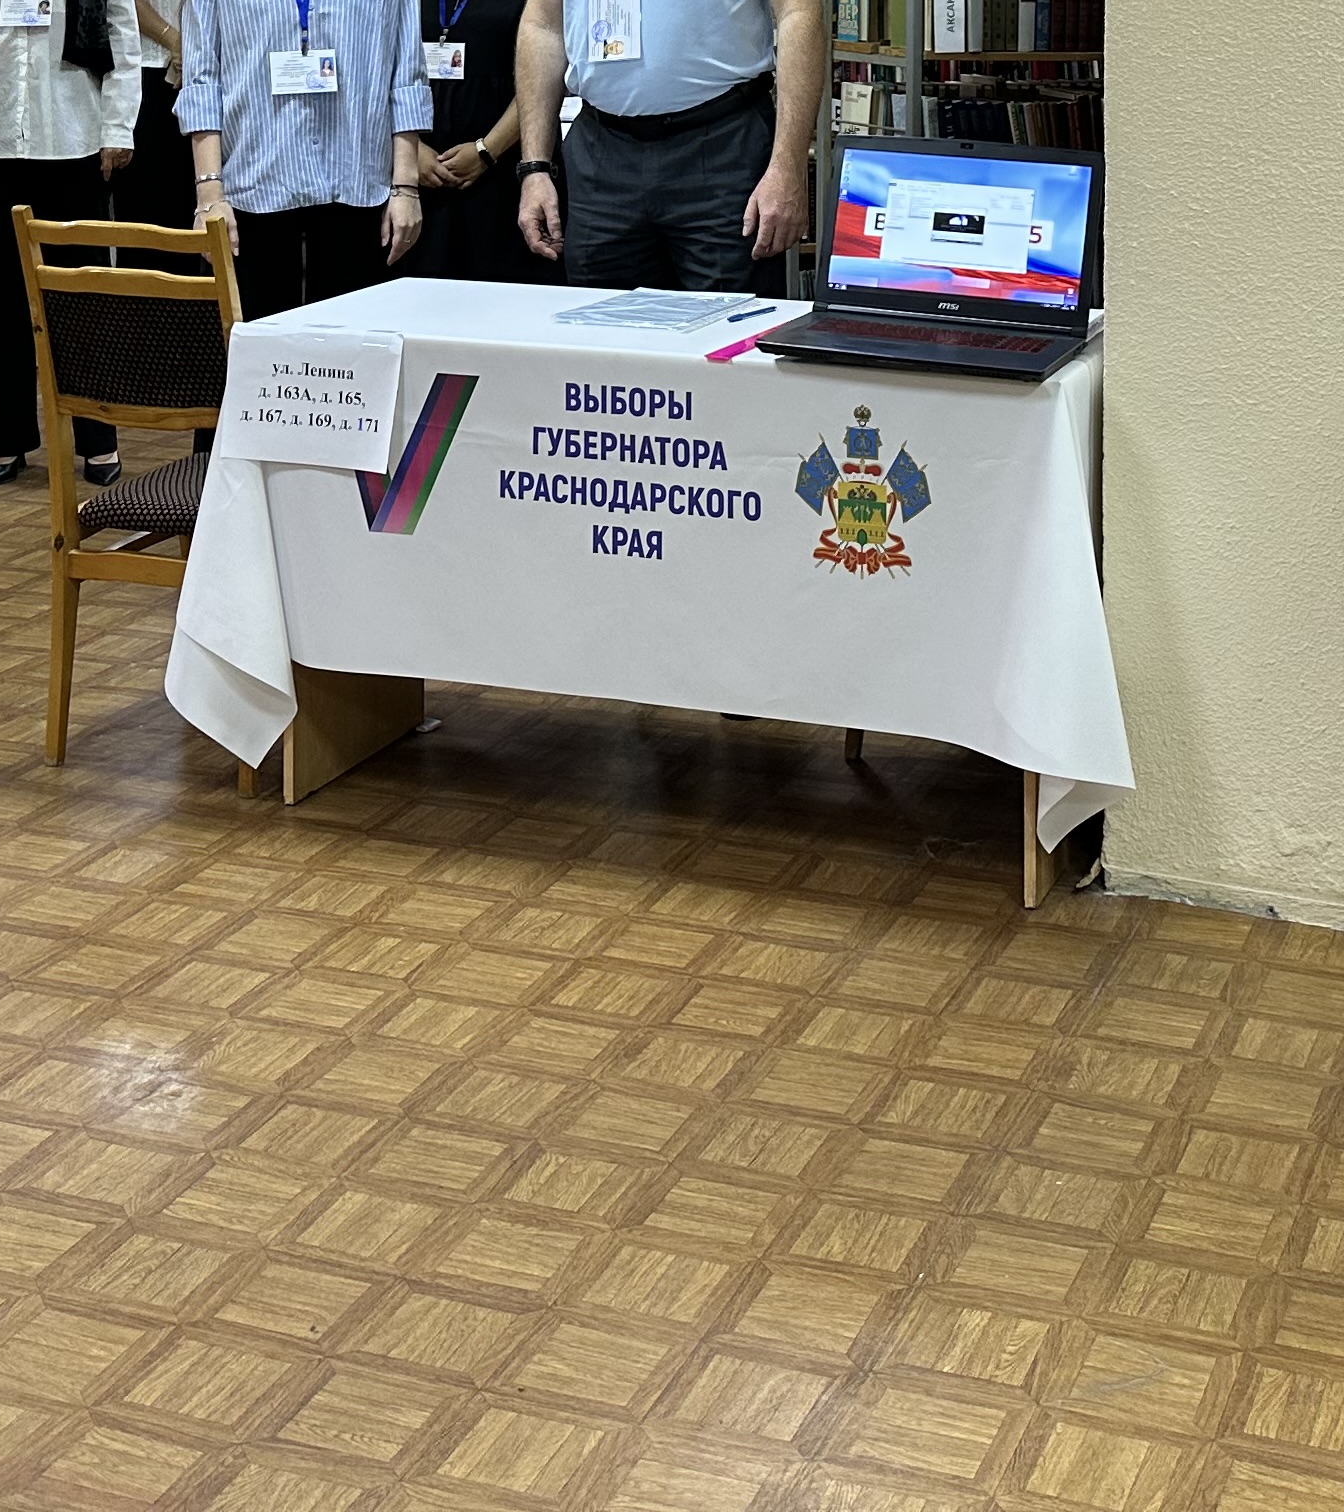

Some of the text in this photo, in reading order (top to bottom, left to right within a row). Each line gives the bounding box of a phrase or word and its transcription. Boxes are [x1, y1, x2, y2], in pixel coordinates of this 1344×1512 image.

[272, 362, 355, 380] ул. Ленина
[258, 385, 366, 408] д. 163А, д. 165,
[565, 382, 692, 421] ВЫБОРЫ
[239, 408, 379, 433] д. 167, д. 169, д. 171
[532, 426, 728, 471] ГУБЕРНАТОРА
[499, 469, 762, 522] КРАСНОДАРСКОГО
[592, 524, 663, 560] КРАЯ
